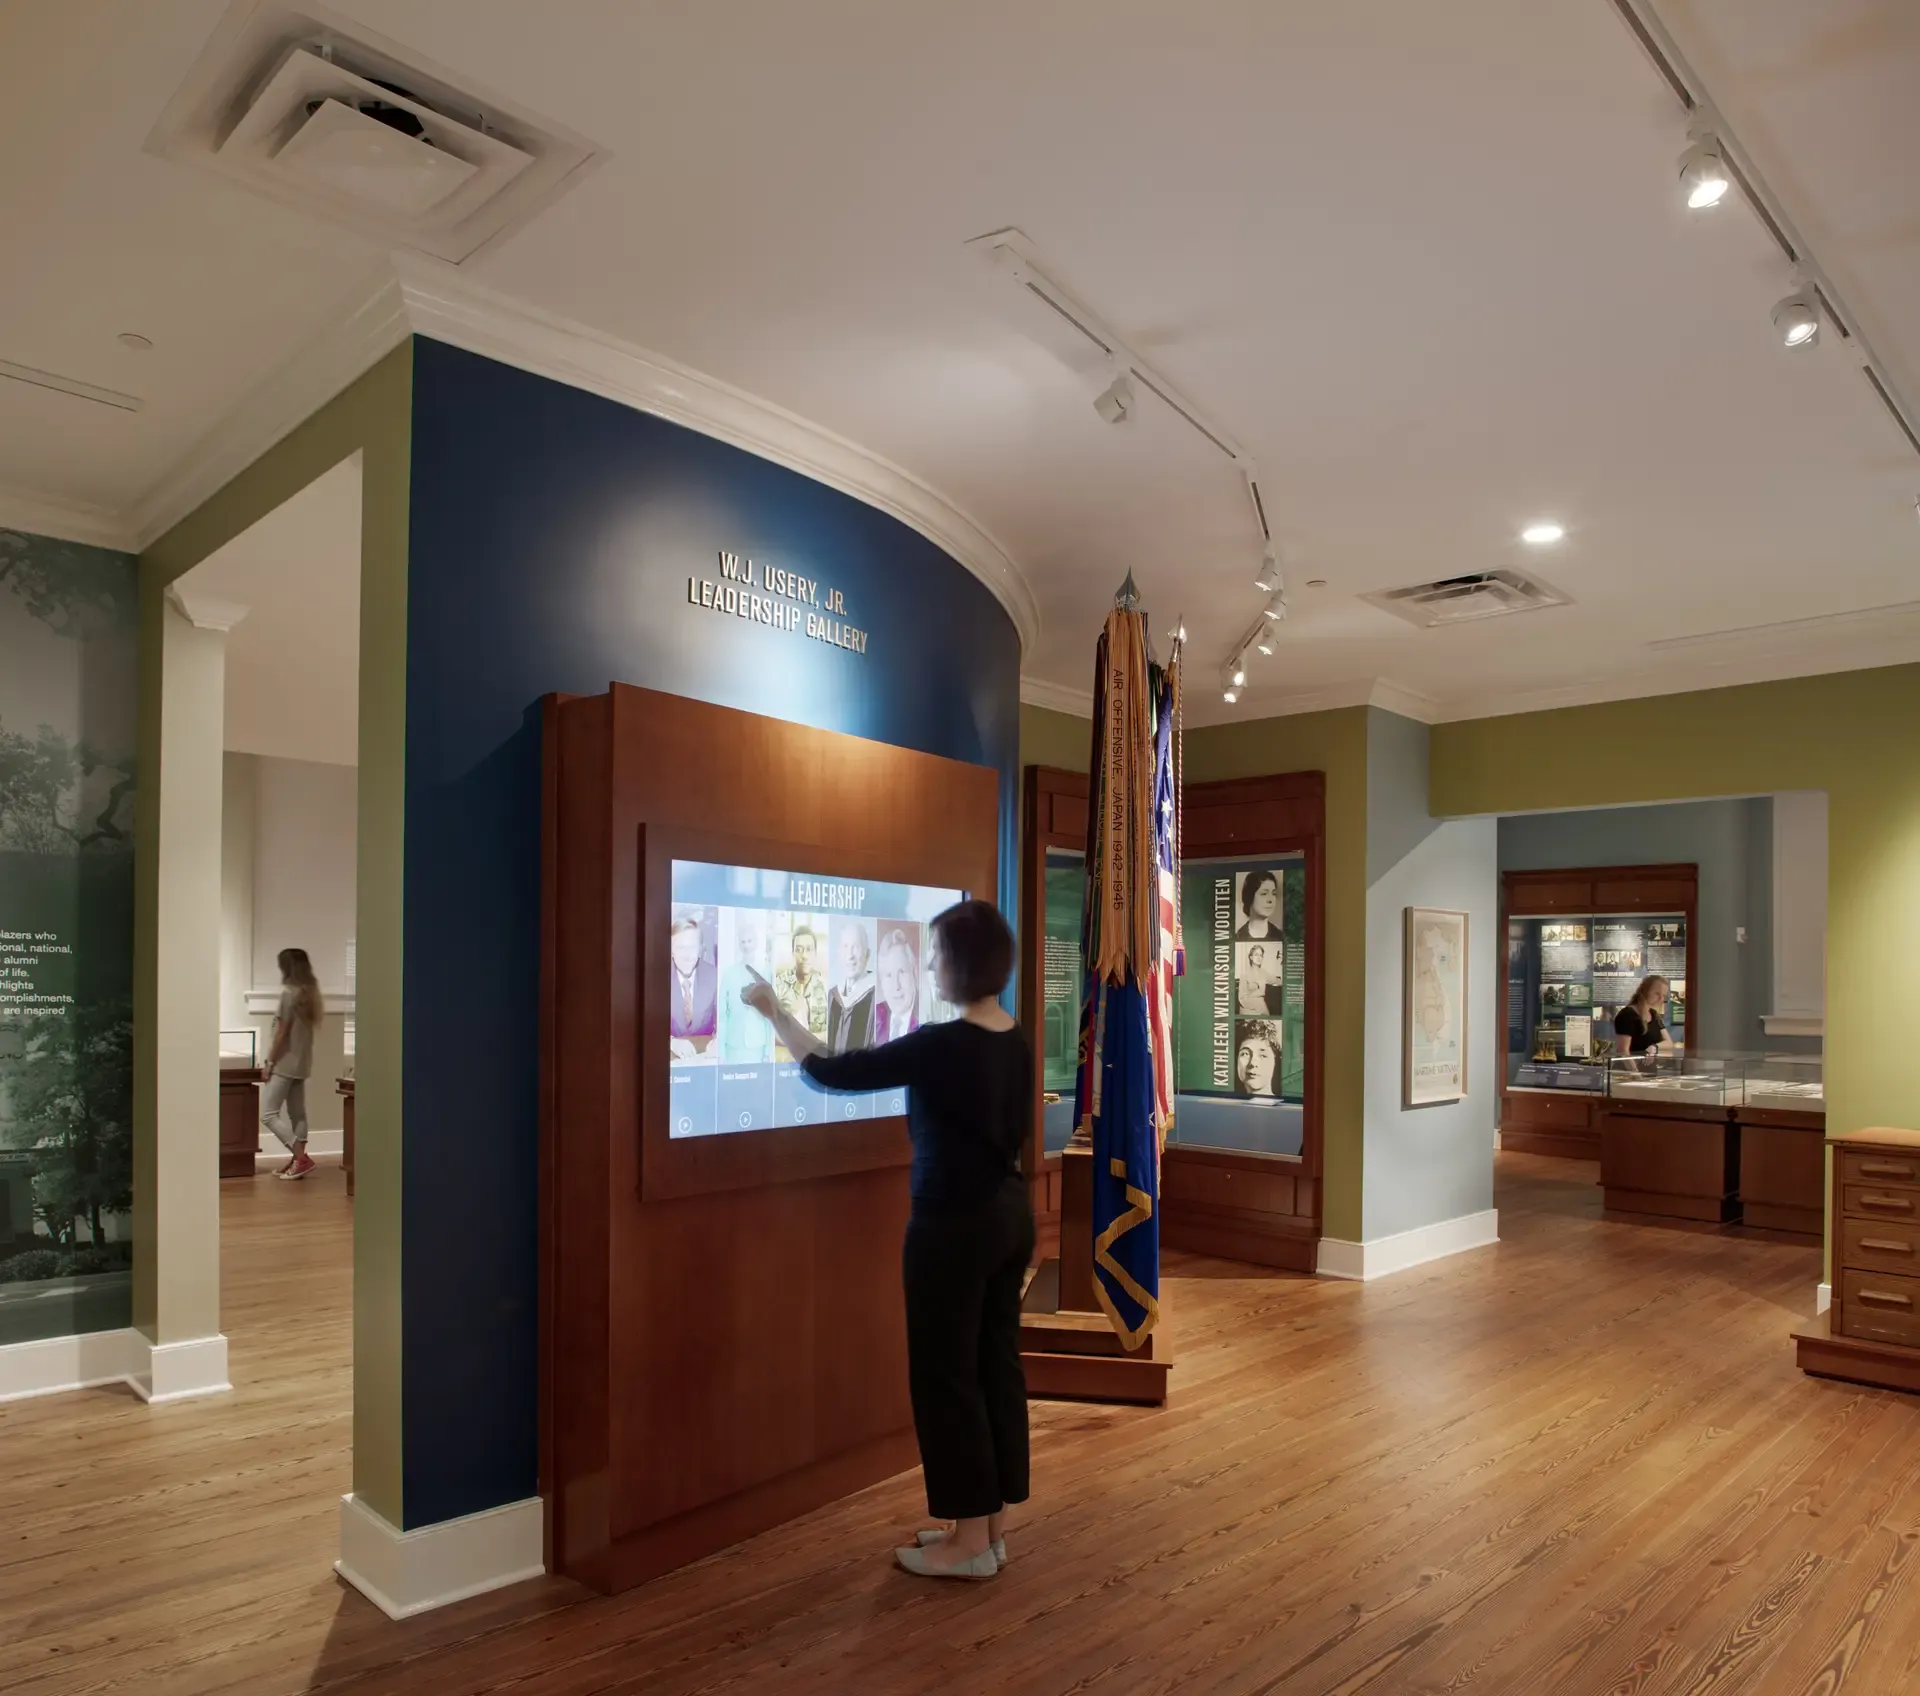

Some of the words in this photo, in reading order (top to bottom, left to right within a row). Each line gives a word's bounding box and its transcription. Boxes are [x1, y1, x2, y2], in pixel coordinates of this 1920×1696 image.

[719, 551, 757, 586] W.J.
[763, 565, 819, 609] USERY,
[824, 588, 848, 616] JR.
[688, 576, 800, 631] LEADERSHIP
[805, 612, 868, 654] GALLERY
[1112, 668, 1124, 690] AIR
[1112, 699, 1123, 780] OFFENSIVE,
[1112, 787, 1123, 831] JAPAN
[790, 879, 865, 910] LEADERSHIP
[1112, 840, 1124, 911] 1942-1945
[1214, 878, 1231, 941] WOOTTEN
[0, 930, 31, 939] lazers
[34, 932, 57, 940] who
[30, 944, 72, 954] national,
[4, 956, 38, 964] alumni
[12, 968, 29, 977] life.
[1213, 945, 1230, 1018] WILKINSON
[24, 1006, 65, 1016] inspired
[1213, 1022, 1229, 1087] KATHLEEN
